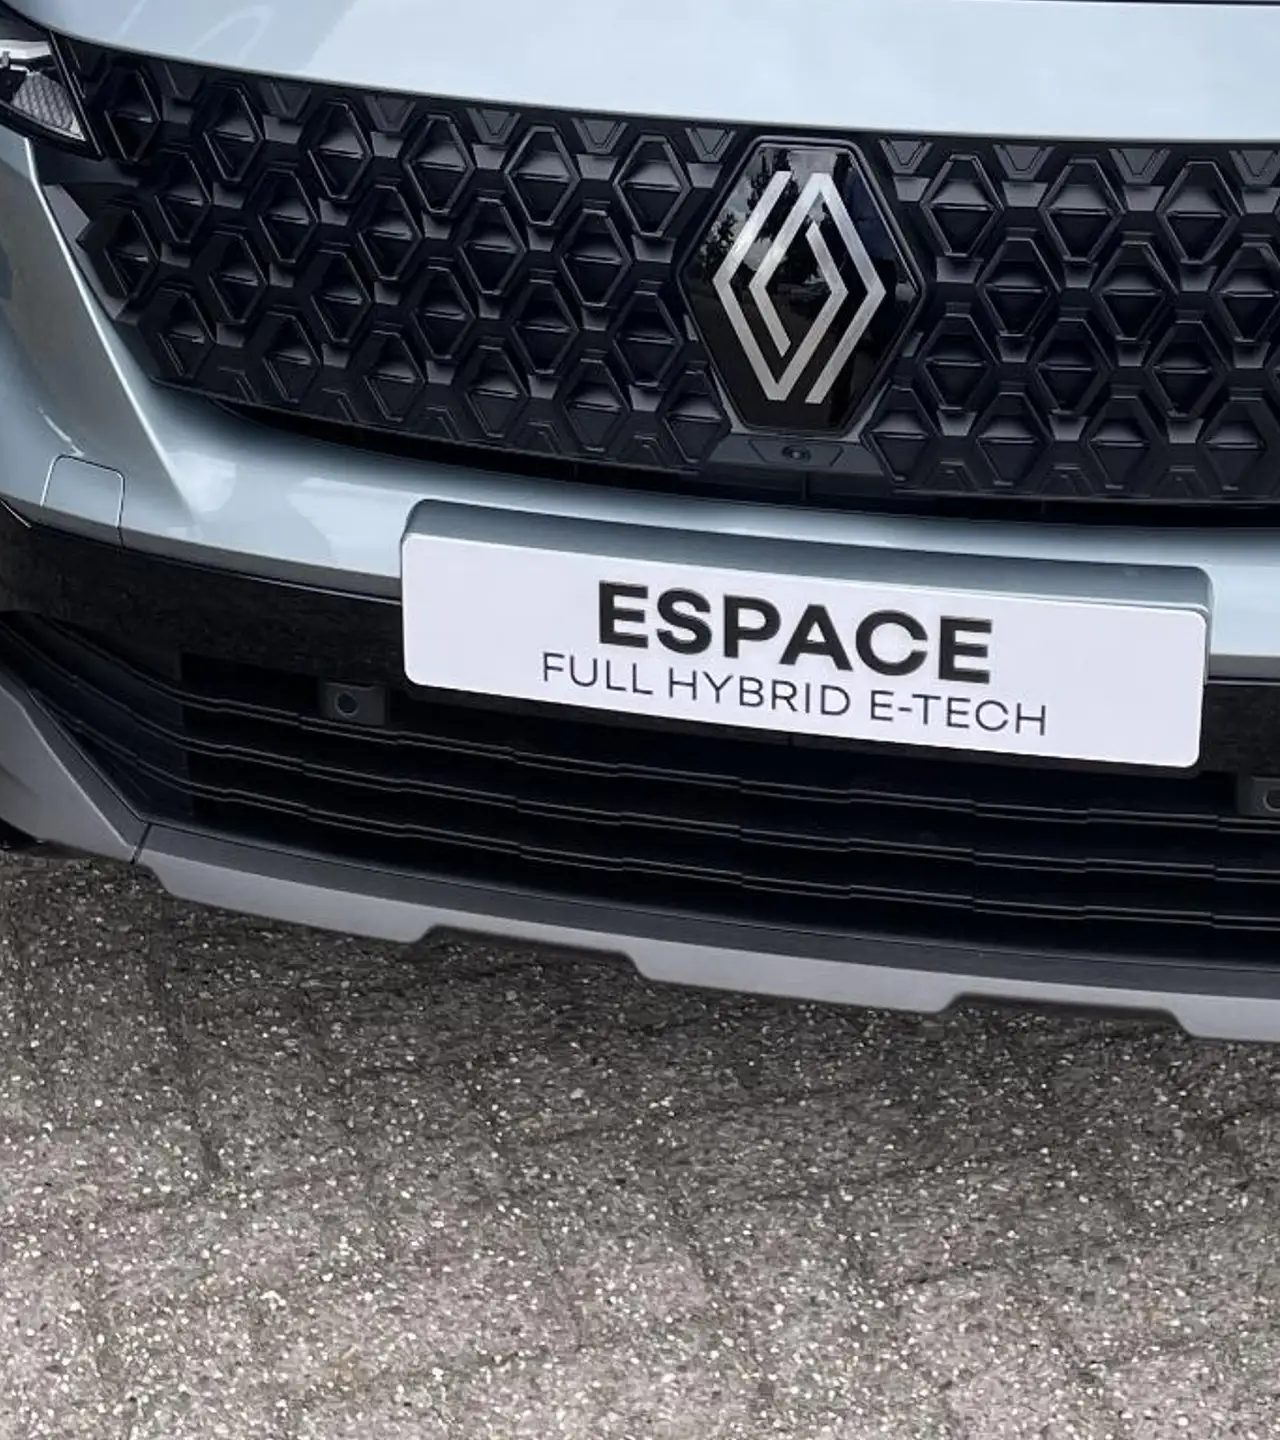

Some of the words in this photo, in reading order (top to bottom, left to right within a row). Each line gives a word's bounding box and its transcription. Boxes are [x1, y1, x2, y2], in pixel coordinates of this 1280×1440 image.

[598, 580, 994, 685] ESPACE
[542, 651, 654, 697] FULL
[668, 666, 852, 717] HYBRID
[870, 688, 1047, 737] E-TECH
